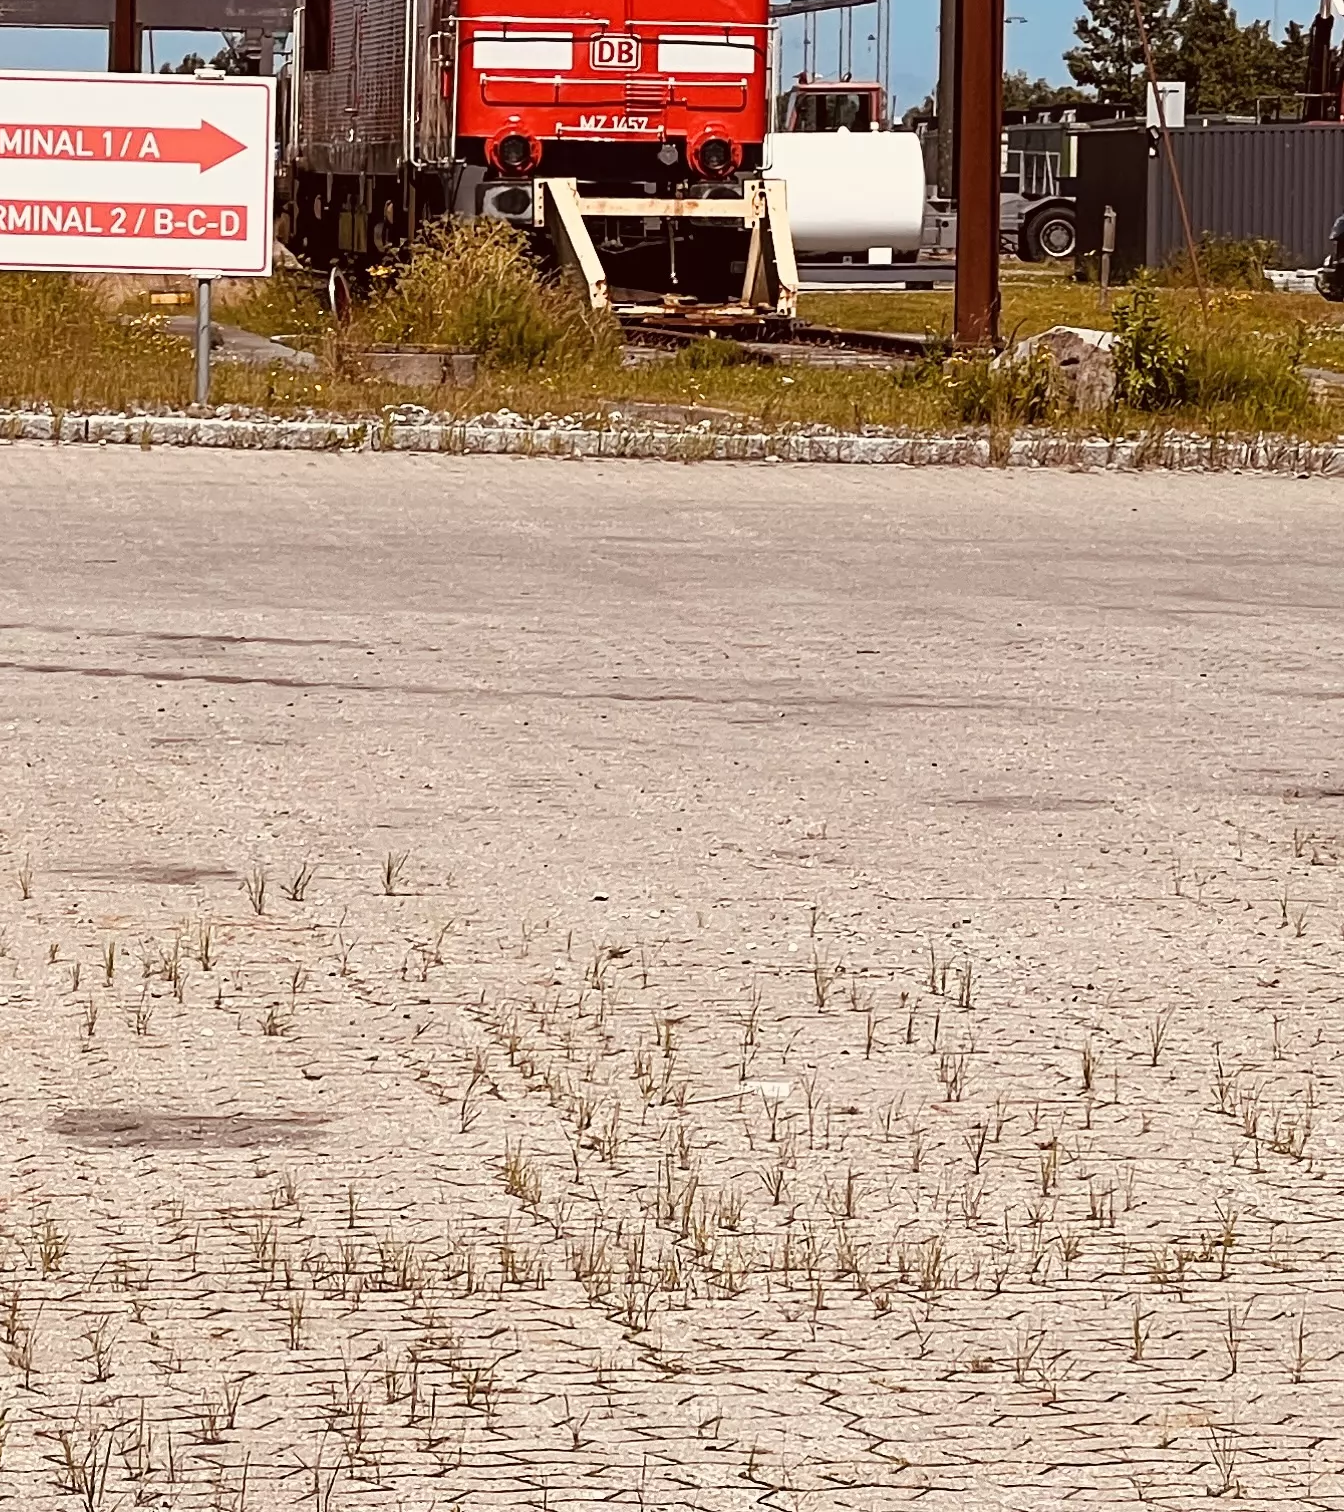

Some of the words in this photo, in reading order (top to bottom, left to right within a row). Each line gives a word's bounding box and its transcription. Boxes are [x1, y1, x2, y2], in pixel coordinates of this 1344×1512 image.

[597, 40, 634, 64] DB
[579, 114, 607, 130] MZ
[612, 115, 649, 131] 1457
[102, 130, 112, 158] 1
[119, 130, 133, 158] /
[138, 131, 161, 159] A
[110, 206, 127, 234] 2
[133, 207, 147, 235] /
[154, 208, 240, 237] B-C-D
